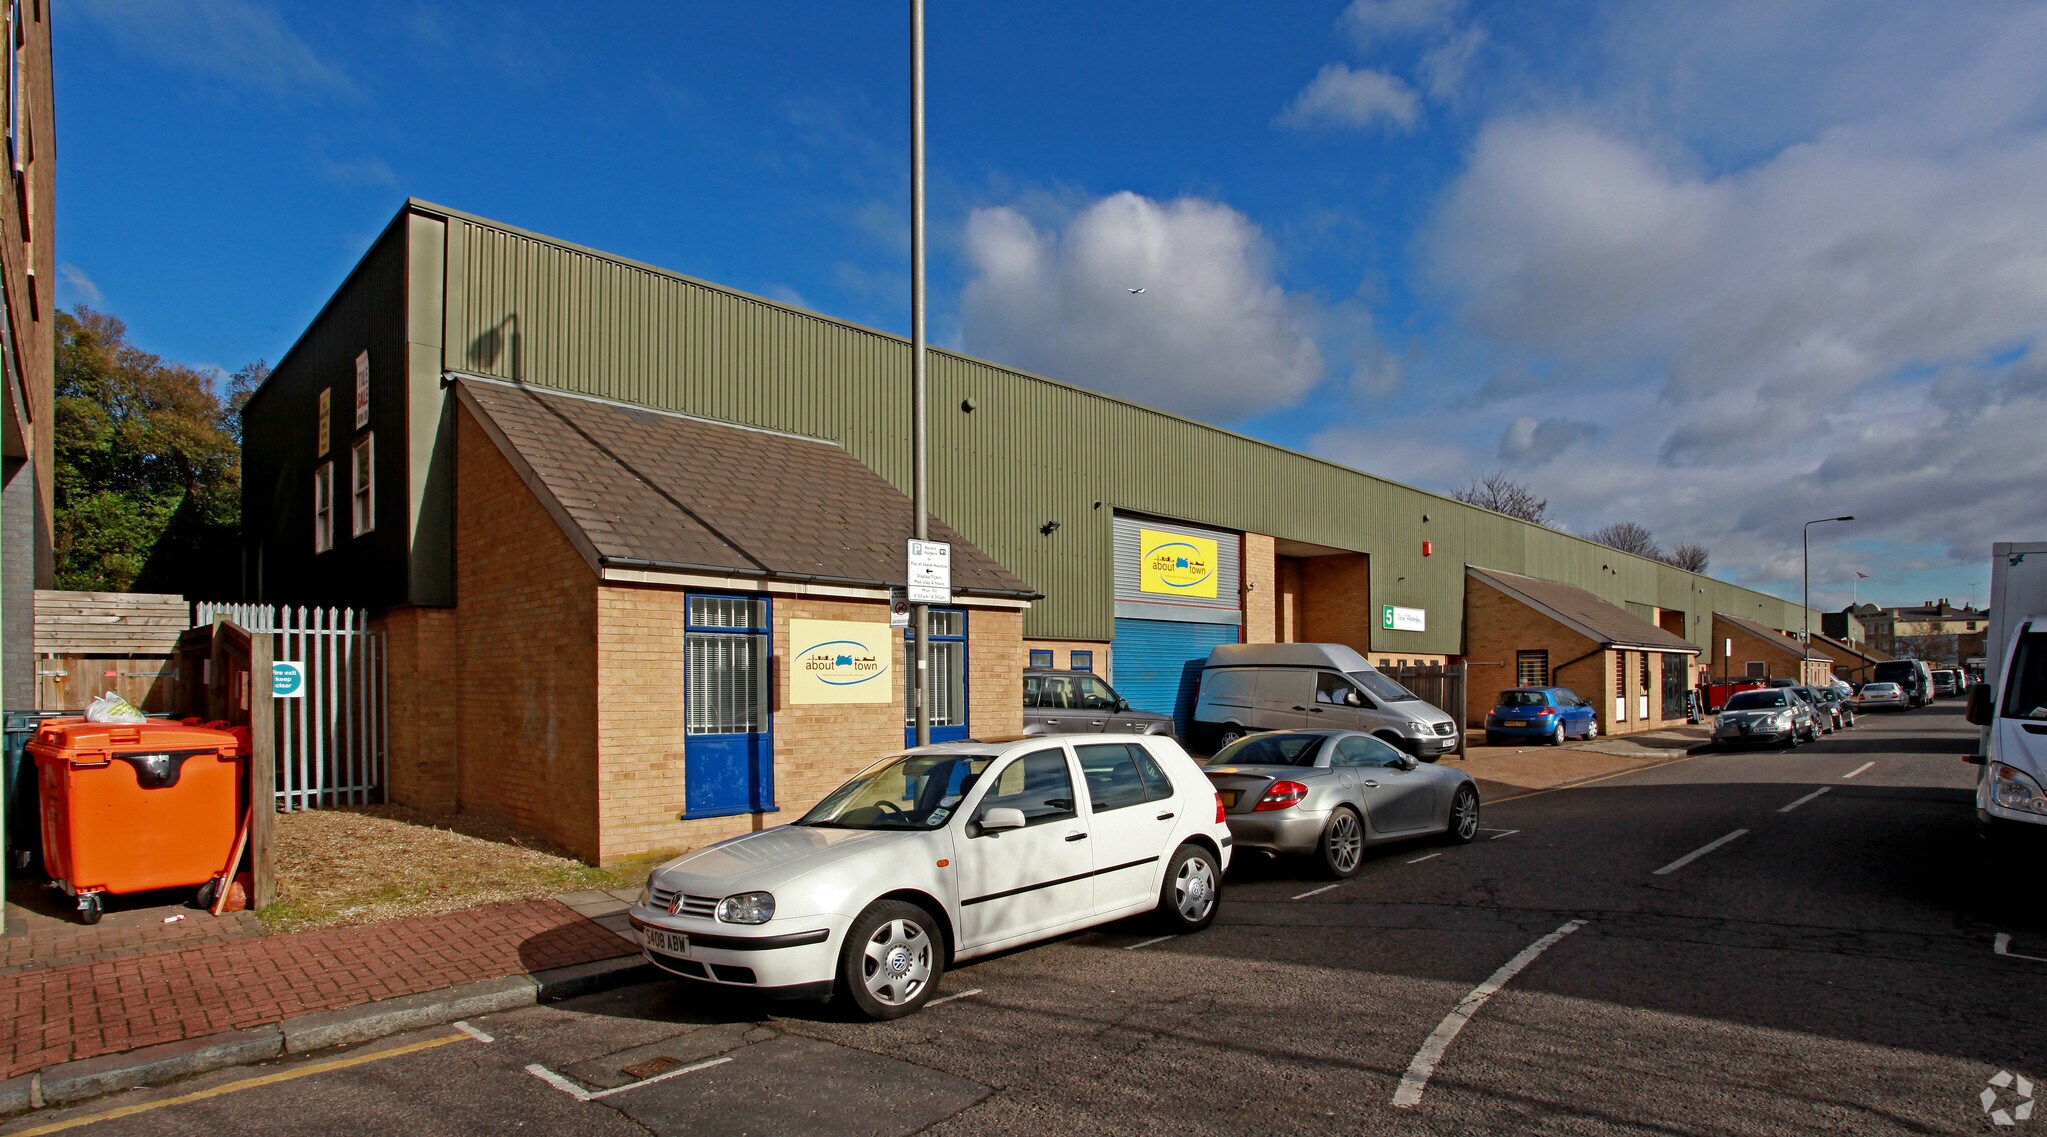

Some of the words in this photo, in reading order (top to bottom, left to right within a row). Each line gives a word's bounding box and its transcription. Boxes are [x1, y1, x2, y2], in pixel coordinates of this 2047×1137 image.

[358, 386, 368, 410] SALE
[1152, 561, 1175, 572] about
[1189, 565, 1206, 575] town
[1386, 609, 1392, 625] 5
[805, 660, 835, 671] about
[854, 661, 878, 671] town
[645, 929, 665, 949] S408
[667, 934, 686, 953] ABW
